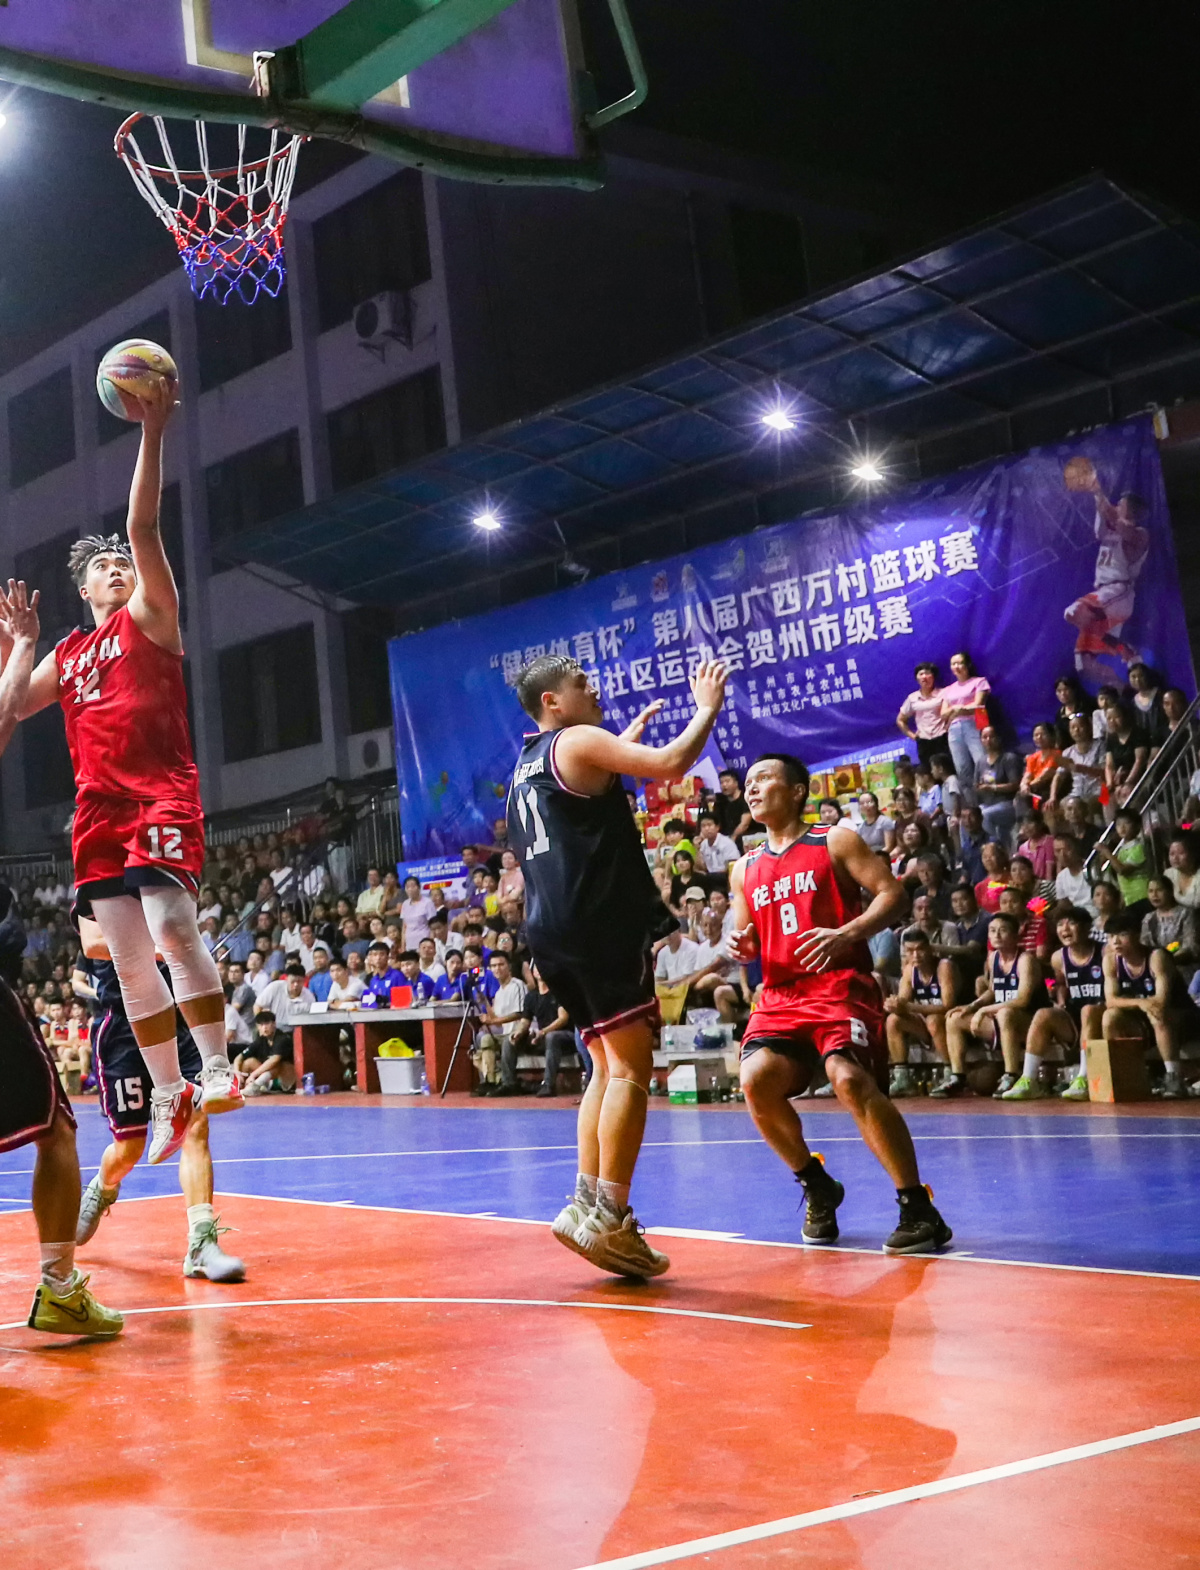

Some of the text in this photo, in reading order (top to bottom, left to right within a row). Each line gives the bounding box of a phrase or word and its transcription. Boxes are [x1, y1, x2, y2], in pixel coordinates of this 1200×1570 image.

[147, 826, 184, 860] 12
[751, 869, 818, 912] 龙坪队
[780, 902, 799, 936] 8
[114, 1076, 144, 1113] 15
